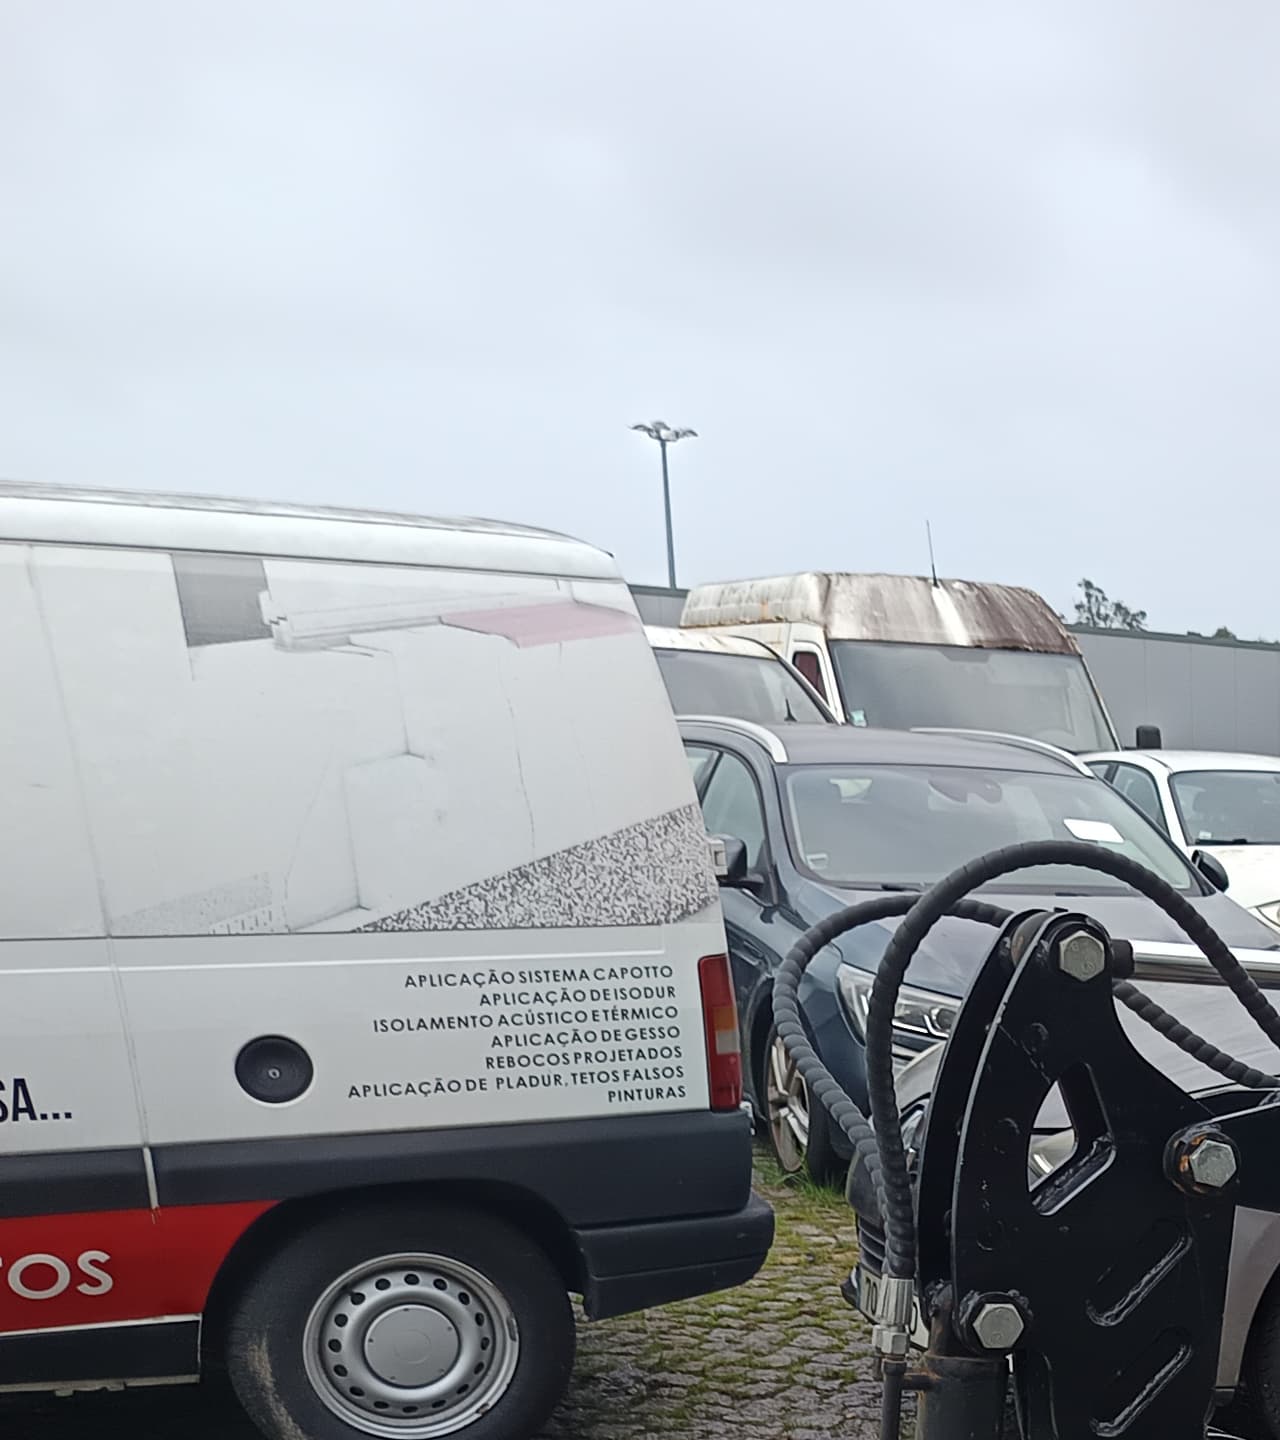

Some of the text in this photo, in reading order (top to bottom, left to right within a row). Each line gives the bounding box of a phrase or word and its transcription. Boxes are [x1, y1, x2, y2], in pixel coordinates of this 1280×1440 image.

[405, 965, 673, 988] APLICAÇÃO SISTEMA CAPOTTO
[480, 986, 676, 1006] APLICAÇÃO DE ISODUR
[373, 1005, 678, 1032] ISOLAMENTO ACÚSTICO E TÉRMICO
[491, 1026, 680, 1048] APLICAÇÃO DE GESSO
[485, 1046, 682, 1069] REBOCOS PROJETADOS
[348, 1078, 461, 1098] APLICAÇÃO
[465, 1078, 488, 1092] DE
[571, 1070, 620, 1085] TETOS
[623, 1065, 684, 1081] FALSOS
[607, 1085, 686, 1102] PINTURAS
[0, 1250, 113, 1300] OS
